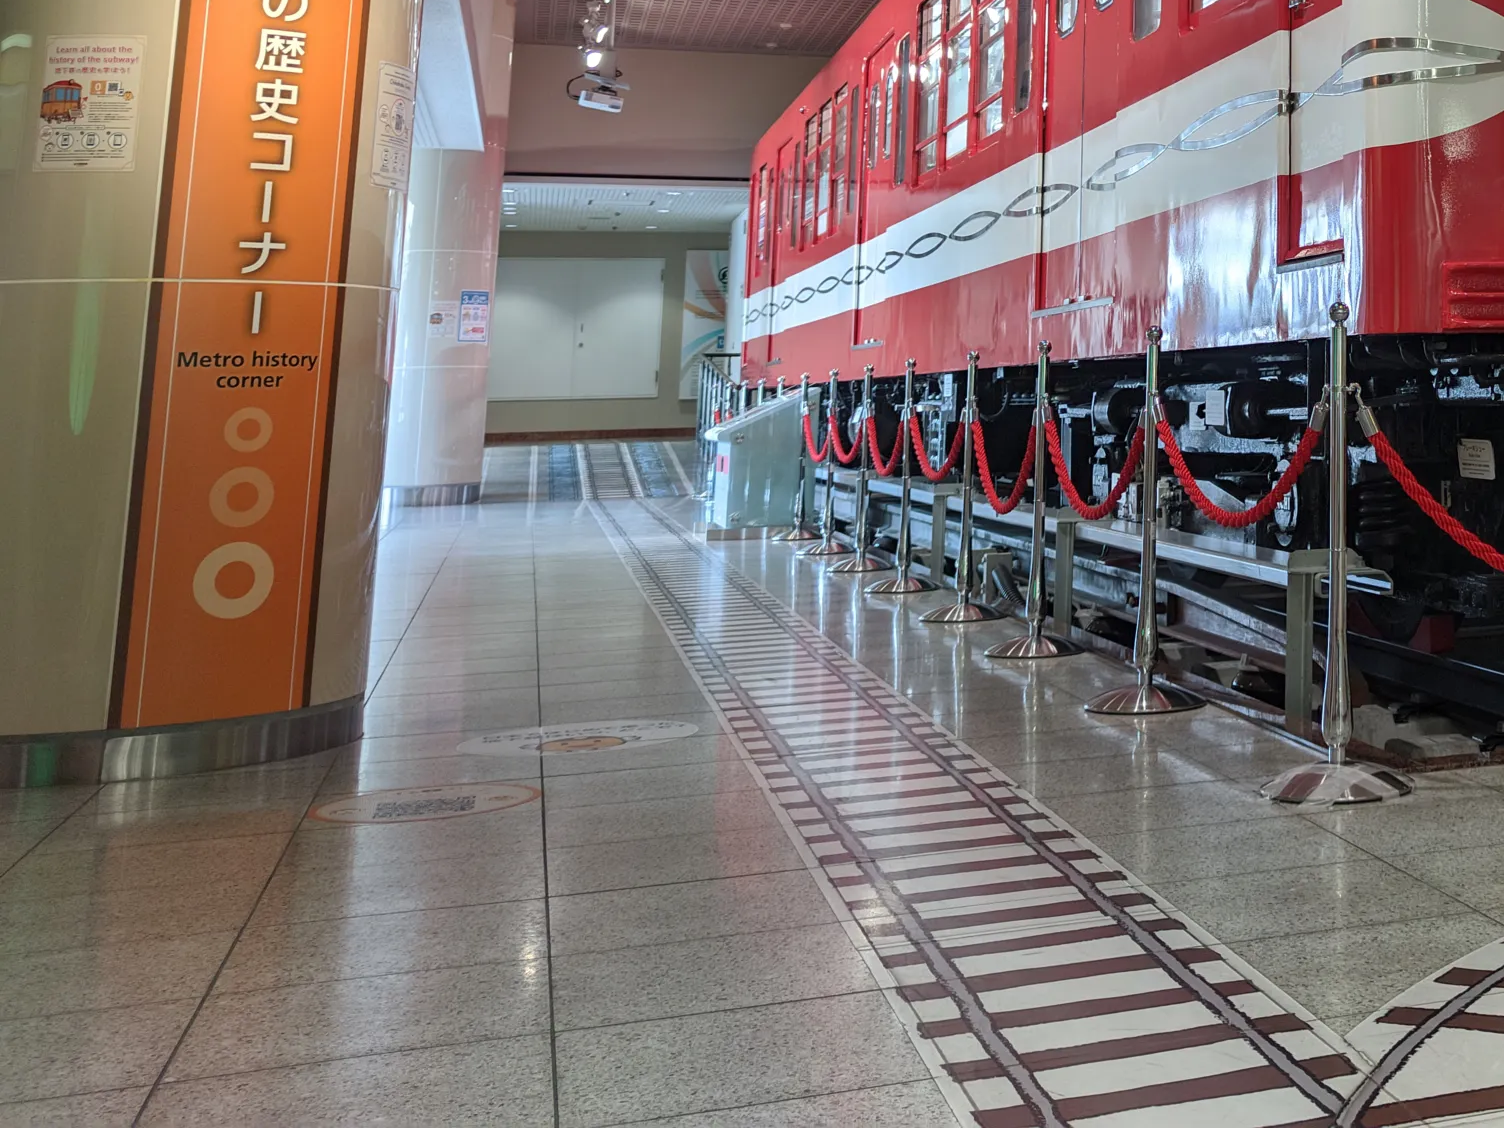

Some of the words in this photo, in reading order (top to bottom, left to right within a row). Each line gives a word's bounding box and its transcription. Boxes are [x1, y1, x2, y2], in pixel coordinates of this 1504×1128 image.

[48, 56, 75, 64] history
[103, 56, 139, 64] subway!
[177, 351, 245, 367] Metro
[251, 350, 319, 371] history
[216, 375, 284, 389] corner
